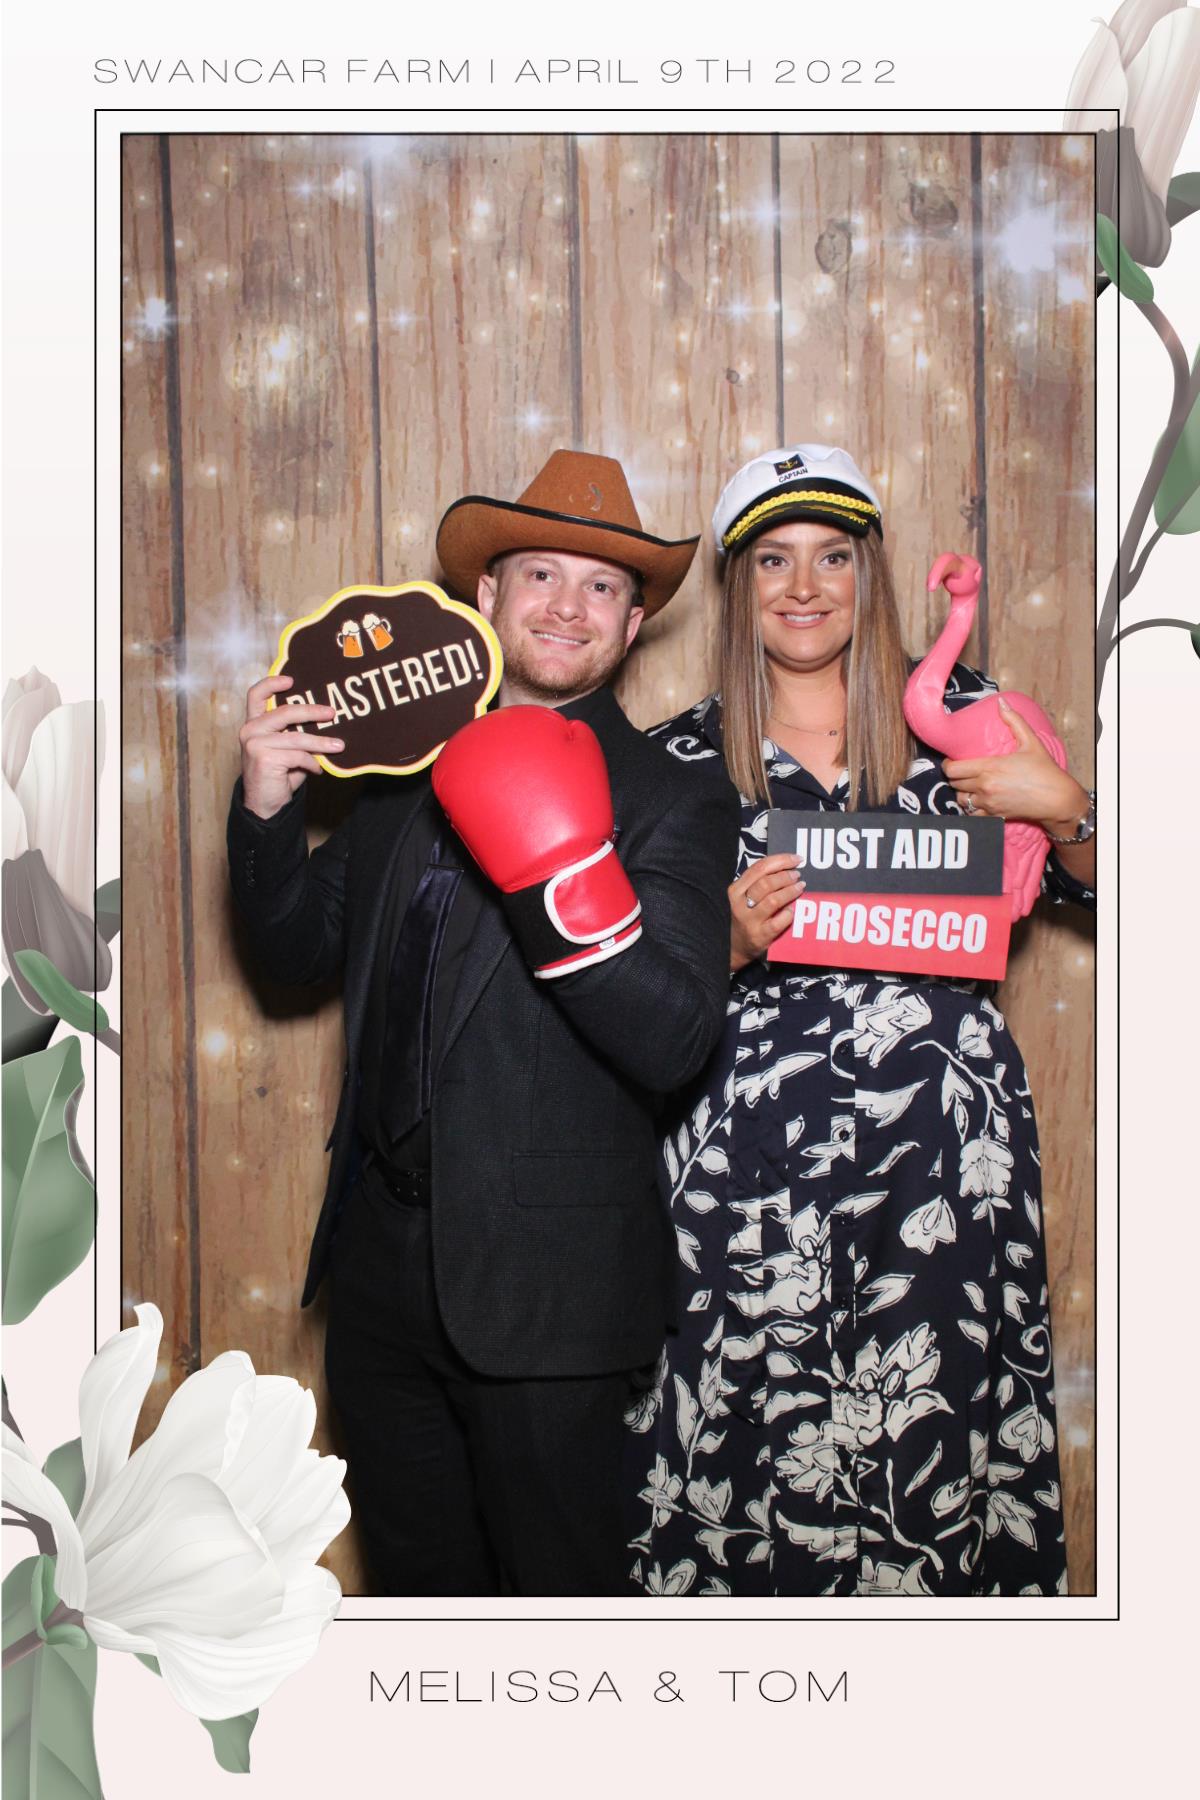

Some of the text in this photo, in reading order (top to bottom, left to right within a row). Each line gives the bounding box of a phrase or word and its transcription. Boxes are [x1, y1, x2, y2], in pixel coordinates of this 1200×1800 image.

[778, 467, 809, 483] CAPTAIN
[796, 828, 970, 870] JUST ADD
[792, 900, 988, 954] PROSECCO
